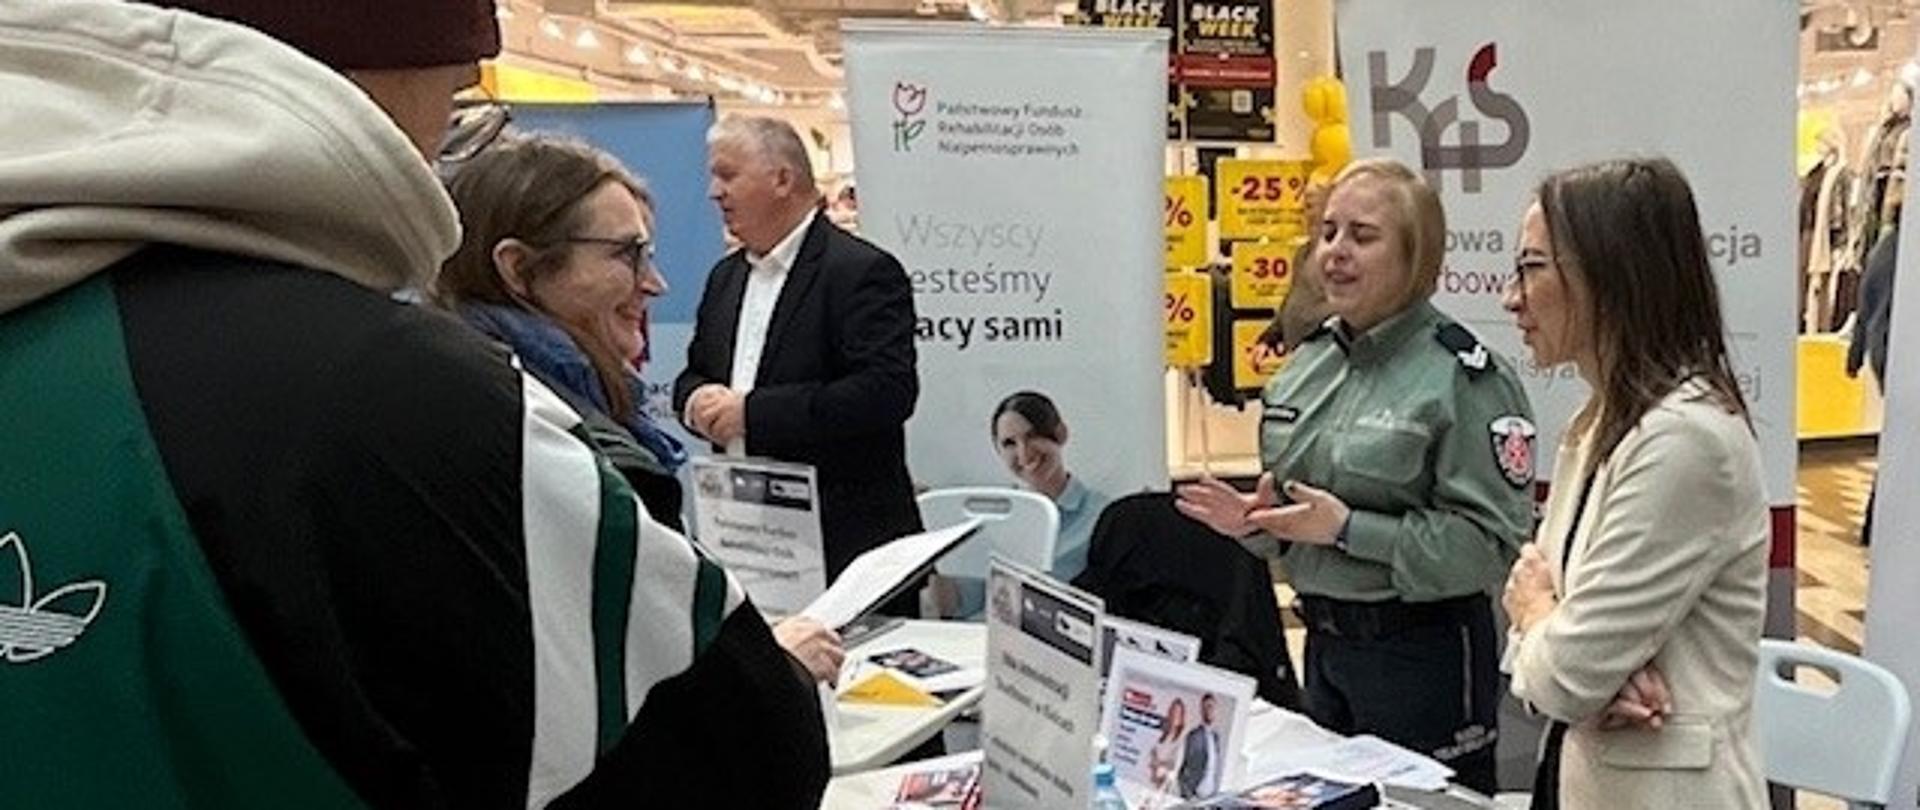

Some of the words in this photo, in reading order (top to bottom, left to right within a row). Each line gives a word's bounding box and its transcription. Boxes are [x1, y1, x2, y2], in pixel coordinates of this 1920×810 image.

[1095, 0, 1164, 16] BLACK
[1192, 5, 1260, 23] BLACK
[1199, 21, 1256, 37] WEEK
[897, 214, 1045, 257] Wszyscy
[1444, 230, 1504, 253] owa
[911, 263, 1052, 302] esteśmy
[915, 314, 975, 350] acy
[984, 308, 1063, 341] sami
